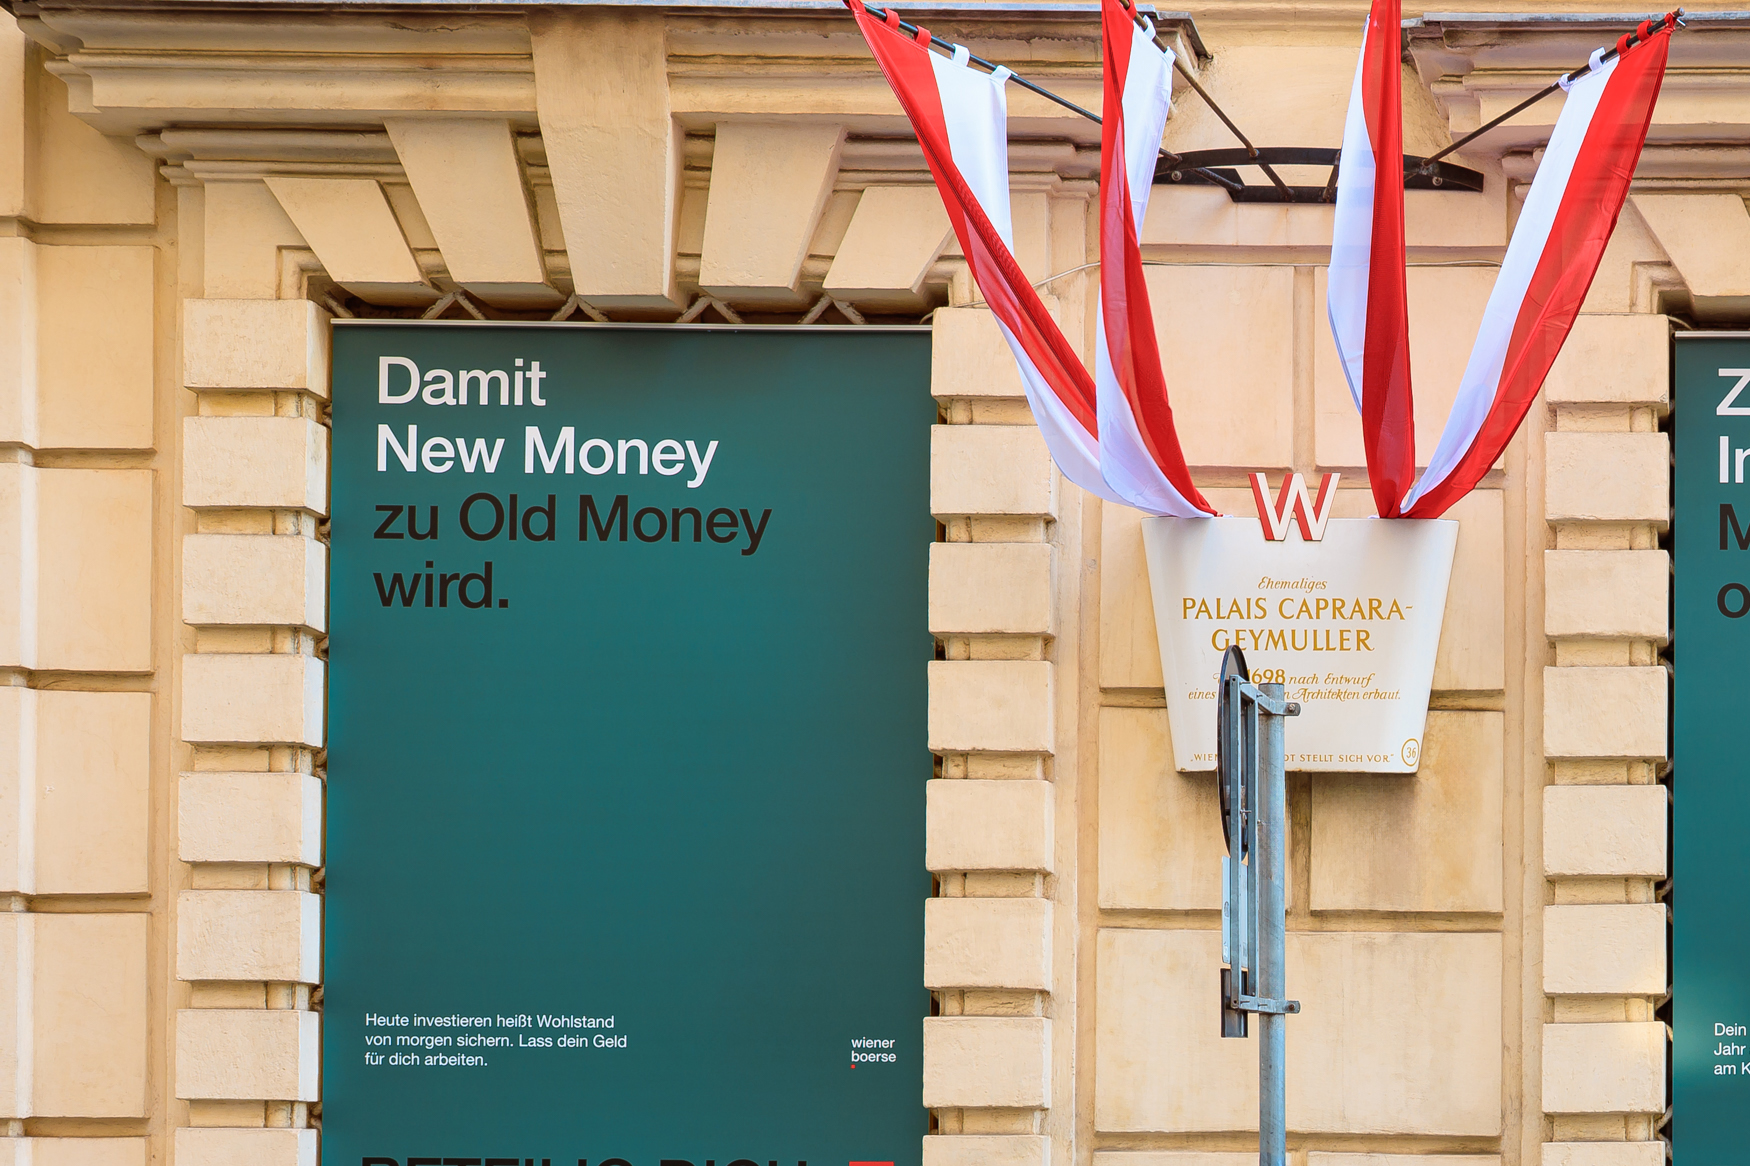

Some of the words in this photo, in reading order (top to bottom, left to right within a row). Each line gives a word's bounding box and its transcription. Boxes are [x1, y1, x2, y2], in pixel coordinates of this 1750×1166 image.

[379, 356, 546, 406] Damit
[378, 424, 505, 473] New
[525, 426, 719, 488] Money
[1248, 473, 1341, 540] W
[374, 505, 438, 540] zu
[460, 493, 556, 541] Old
[579, 495, 772, 556] Money
[373, 561, 508, 608] wird.
[1258, 576, 1327, 591] Ehemaliges
[1183, 598, 1266, 619] PALAIS
[1279, 598, 1412, 620] CAPRARA-
[1289, 674, 1318, 684] nach
[1324, 673, 1375, 688] Entwurf
[1189, 688, 1216, 699] eines
[1292, 688, 1359, 703] Architekten
[1300, 754, 1333, 762] STELLT
[1407, 747, 1416, 758] 36
[366, 1013, 409, 1026] Heute
[414, 1014, 491, 1027] investieren
[497, 1014, 532, 1027] heißt
[537, 1015, 614, 1028] Wohlstand
[1715, 1023, 1746, 1036] Dein
[365, 1036, 391, 1045] von
[397, 1036, 452, 1049] morgen
[457, 1034, 513, 1046] sichern.
[520, 1034, 553, 1047] Lass
[558, 1035, 588, 1047] dein
[593, 1035, 627, 1047] Geld
[851, 1037, 895, 1048] wiener
[1714, 1042, 1746, 1055] Jahr
[365, 1052, 385, 1065] für
[389, 1053, 419, 1065] dich
[425, 1053, 487, 1066] arbeiten.
[852, 1051, 896, 1062] boerse
[1714, 1065, 1736, 1075] am
